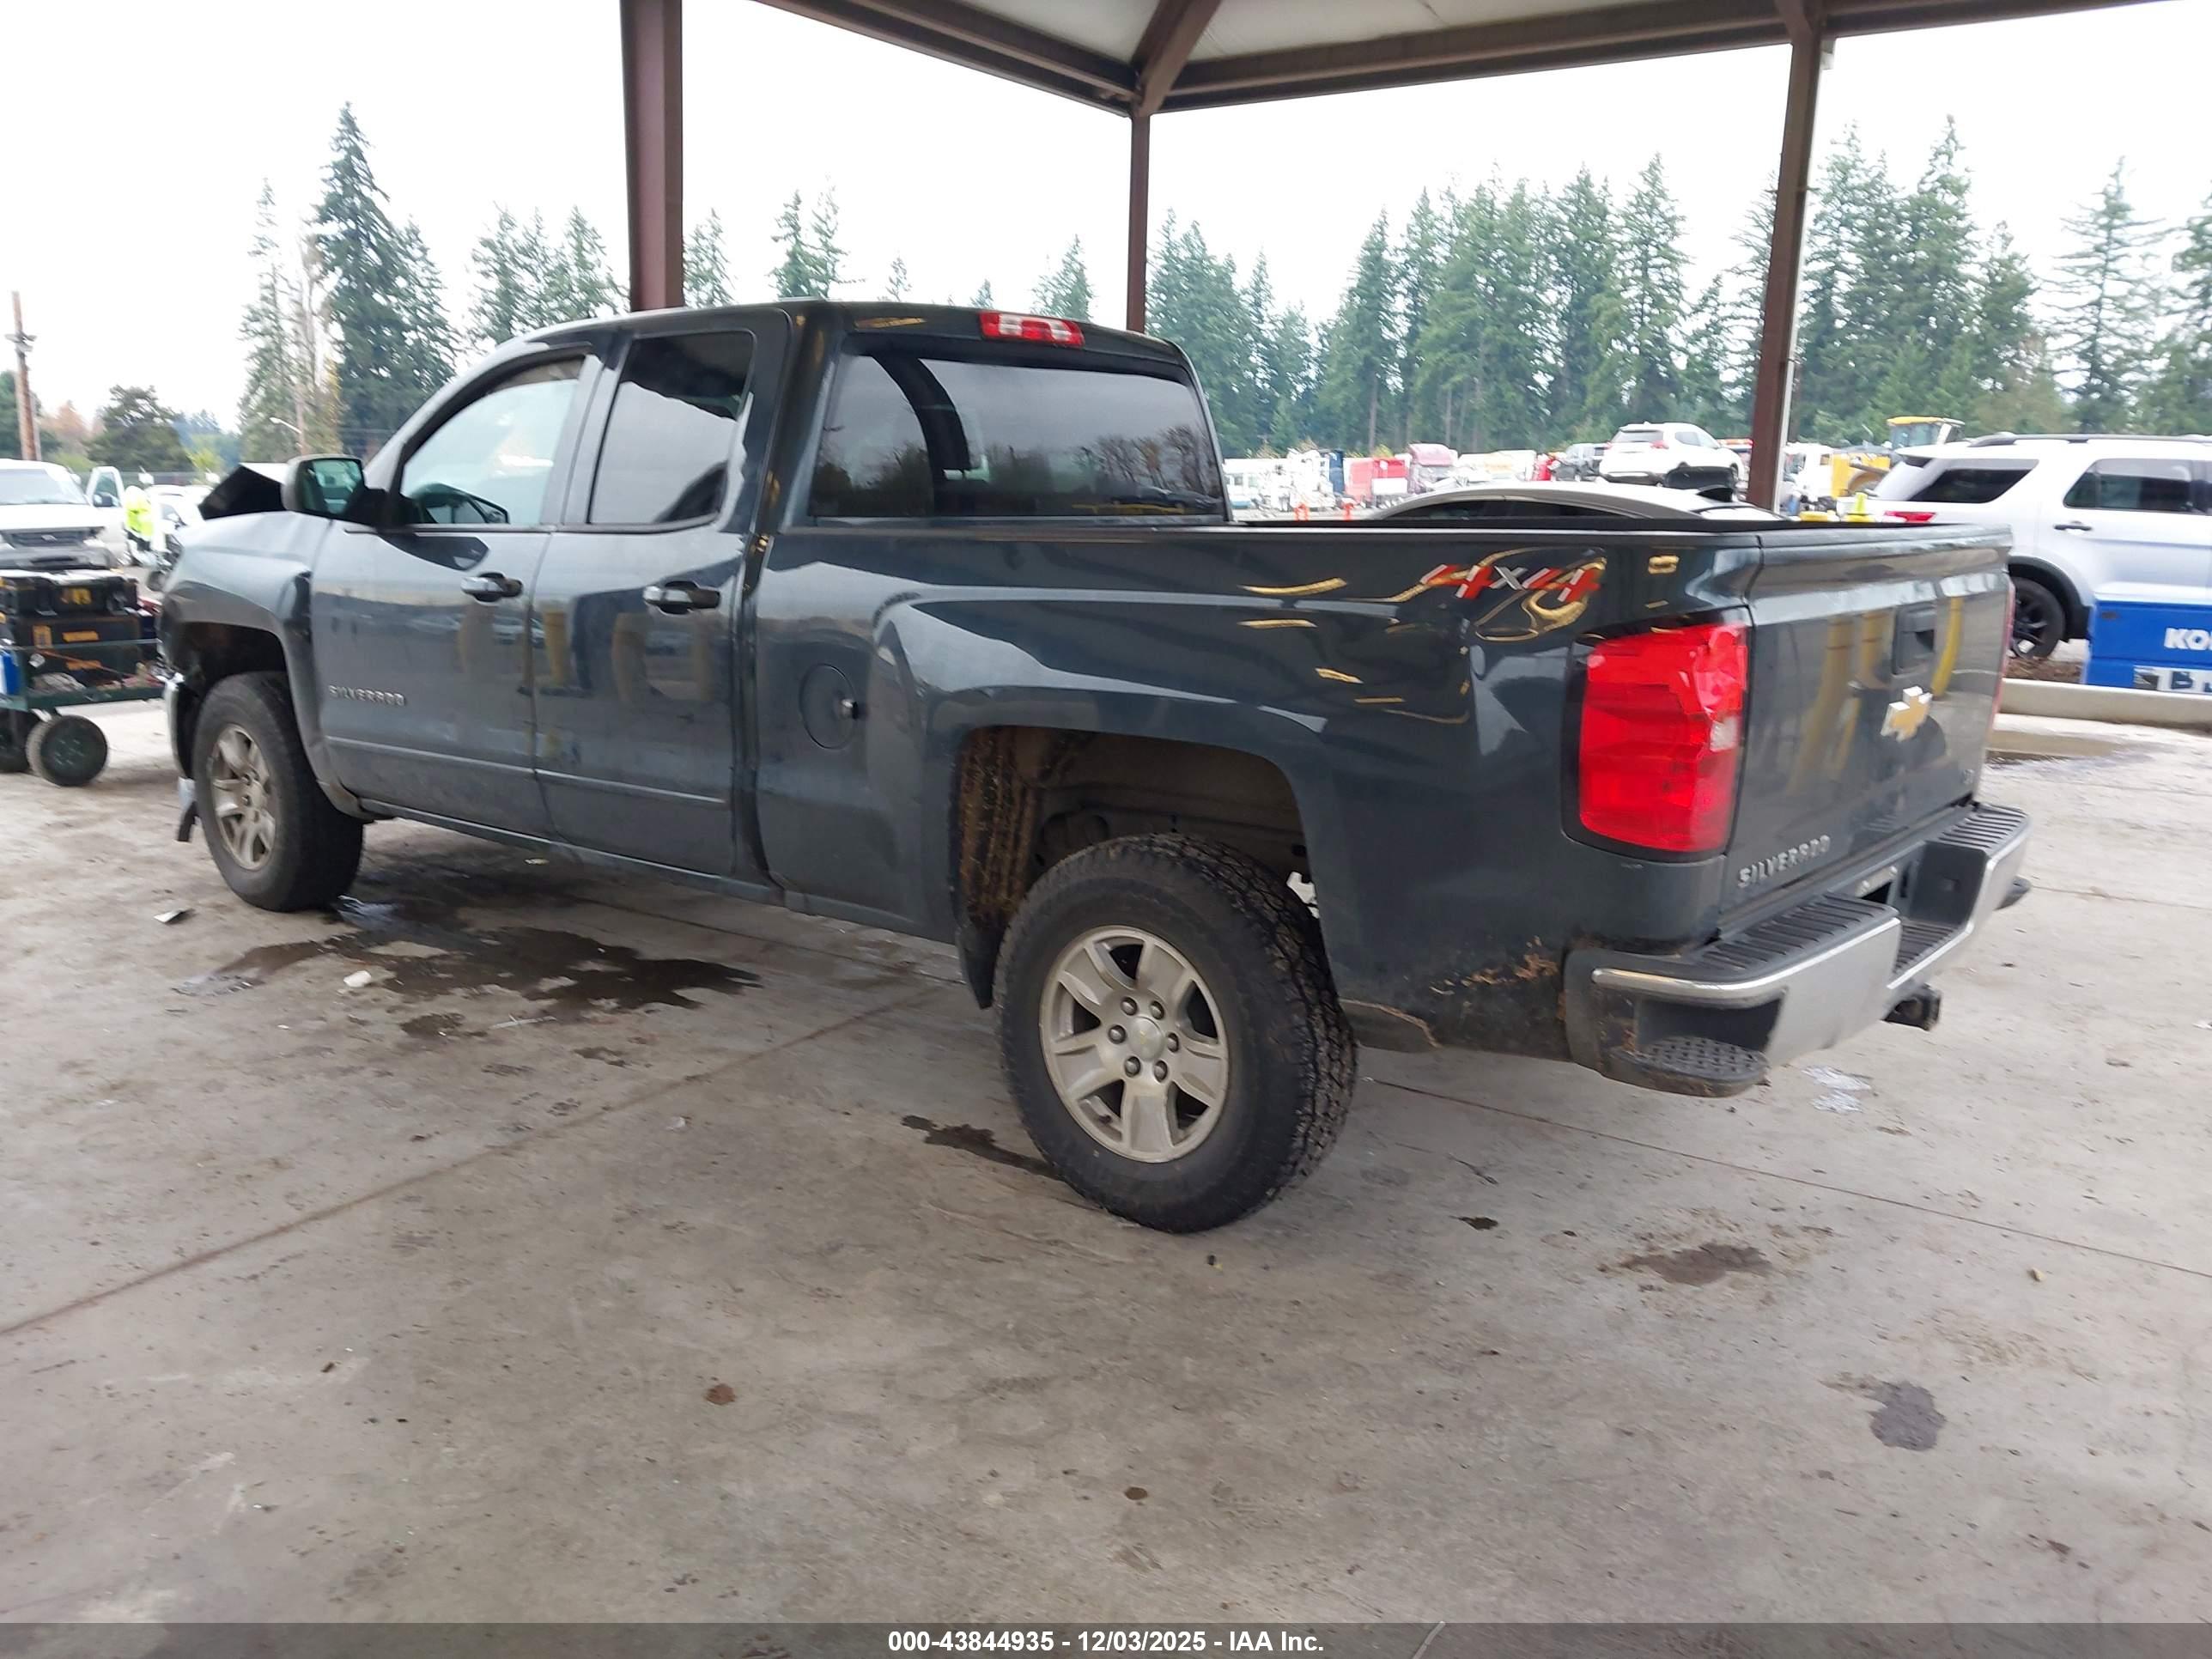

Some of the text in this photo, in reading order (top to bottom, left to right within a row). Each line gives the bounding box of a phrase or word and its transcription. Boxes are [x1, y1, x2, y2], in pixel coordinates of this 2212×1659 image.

[2164, 627, 2212, 651] KO
[329, 684, 406, 707] SILVERADO
[1738, 835, 1831, 888] SILVERADO
